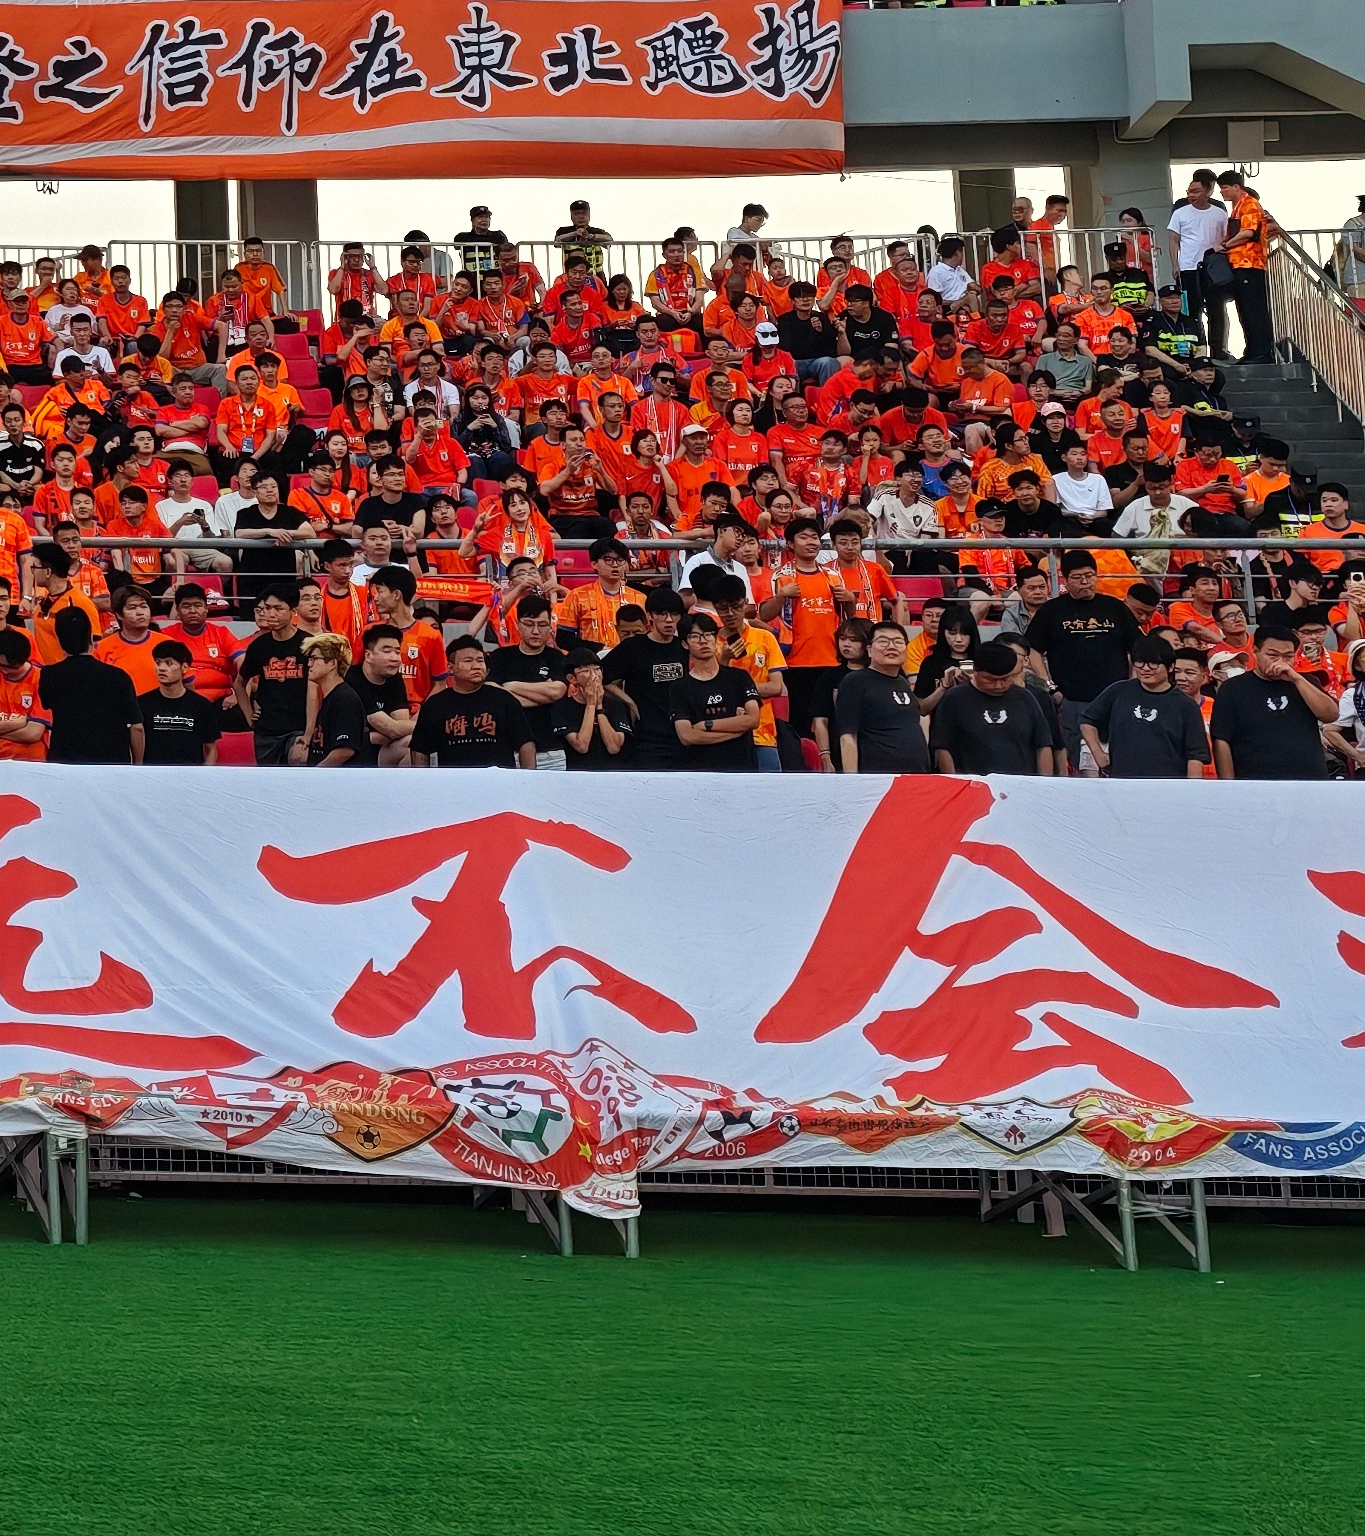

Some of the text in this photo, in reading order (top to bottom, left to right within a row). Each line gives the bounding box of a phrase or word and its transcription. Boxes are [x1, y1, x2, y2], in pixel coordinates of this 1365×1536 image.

[1062, 617, 1115, 630] 只有泰山
[211, 1108, 244, 1122] 2010
[704, 1141, 747, 1158] 2006
[1243, 1132, 1294, 1161] FANS
[453, 1138, 524, 1182] TIANJIN
